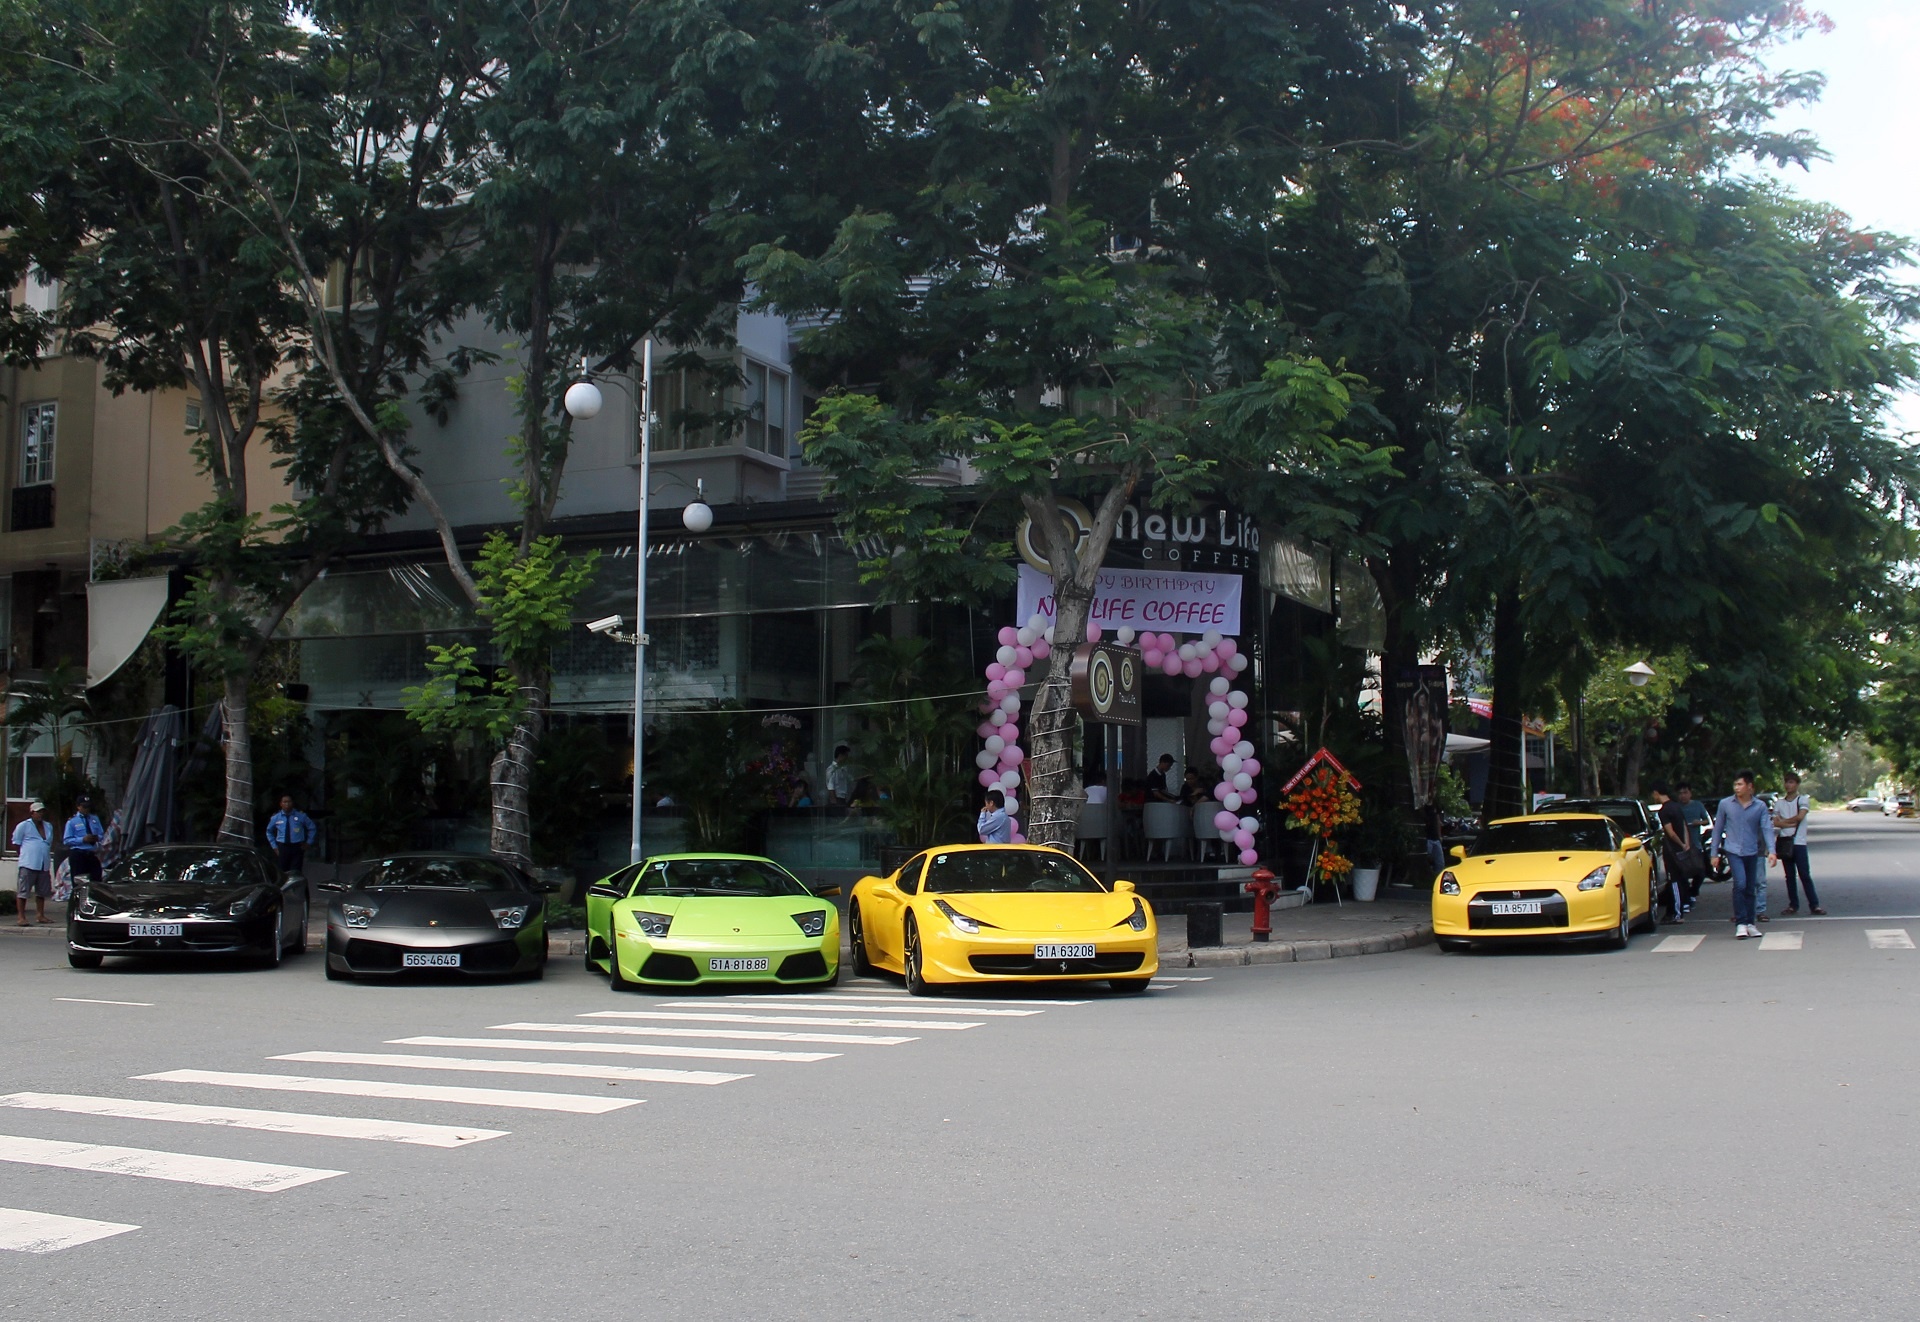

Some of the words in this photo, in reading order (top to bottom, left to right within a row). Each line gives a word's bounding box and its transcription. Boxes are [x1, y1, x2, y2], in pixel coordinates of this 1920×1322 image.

[1142, 547, 1249, 569] COFFEE
[1121, 575, 1216, 594] BIRTHDAY
[1092, 597, 1136, 620] LIFE
[1143, 600, 1225, 624] COFFEE
